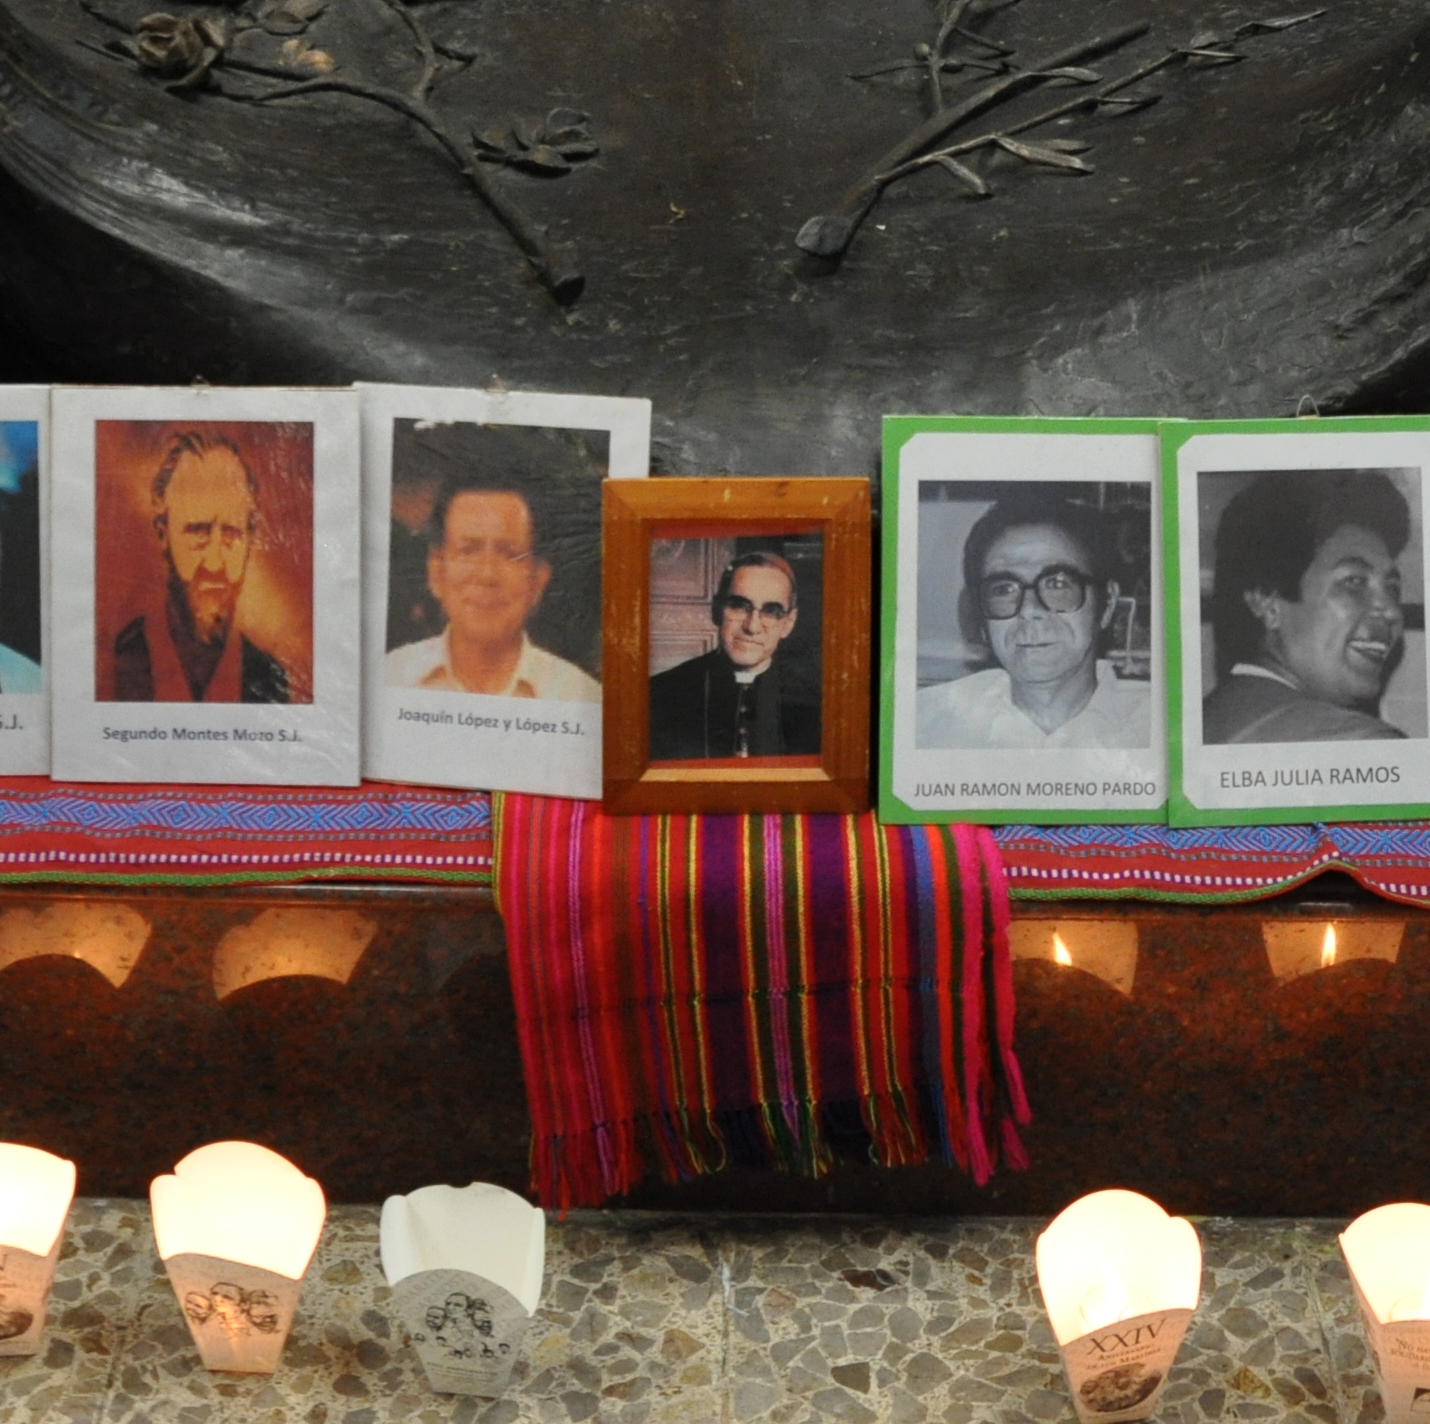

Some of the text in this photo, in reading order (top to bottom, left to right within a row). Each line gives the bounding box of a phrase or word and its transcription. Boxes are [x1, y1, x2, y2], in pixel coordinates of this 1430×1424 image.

[102, 727, 168, 743] Segundo
[172, 727, 229, 741] Montes
[278, 729, 302, 743] S.J.
[457, 711, 499, 730] López
[503, 718, 512, 732] y
[516, 716, 557, 735] López
[561, 721, 586, 736] S.J.
[914, 781, 1157, 797] JUAN RAMON MORENO PARDO
[1220, 765, 1401, 789] ELBA JULIA RAMOS
[1087, 1317, 1167, 1355] XXIV
